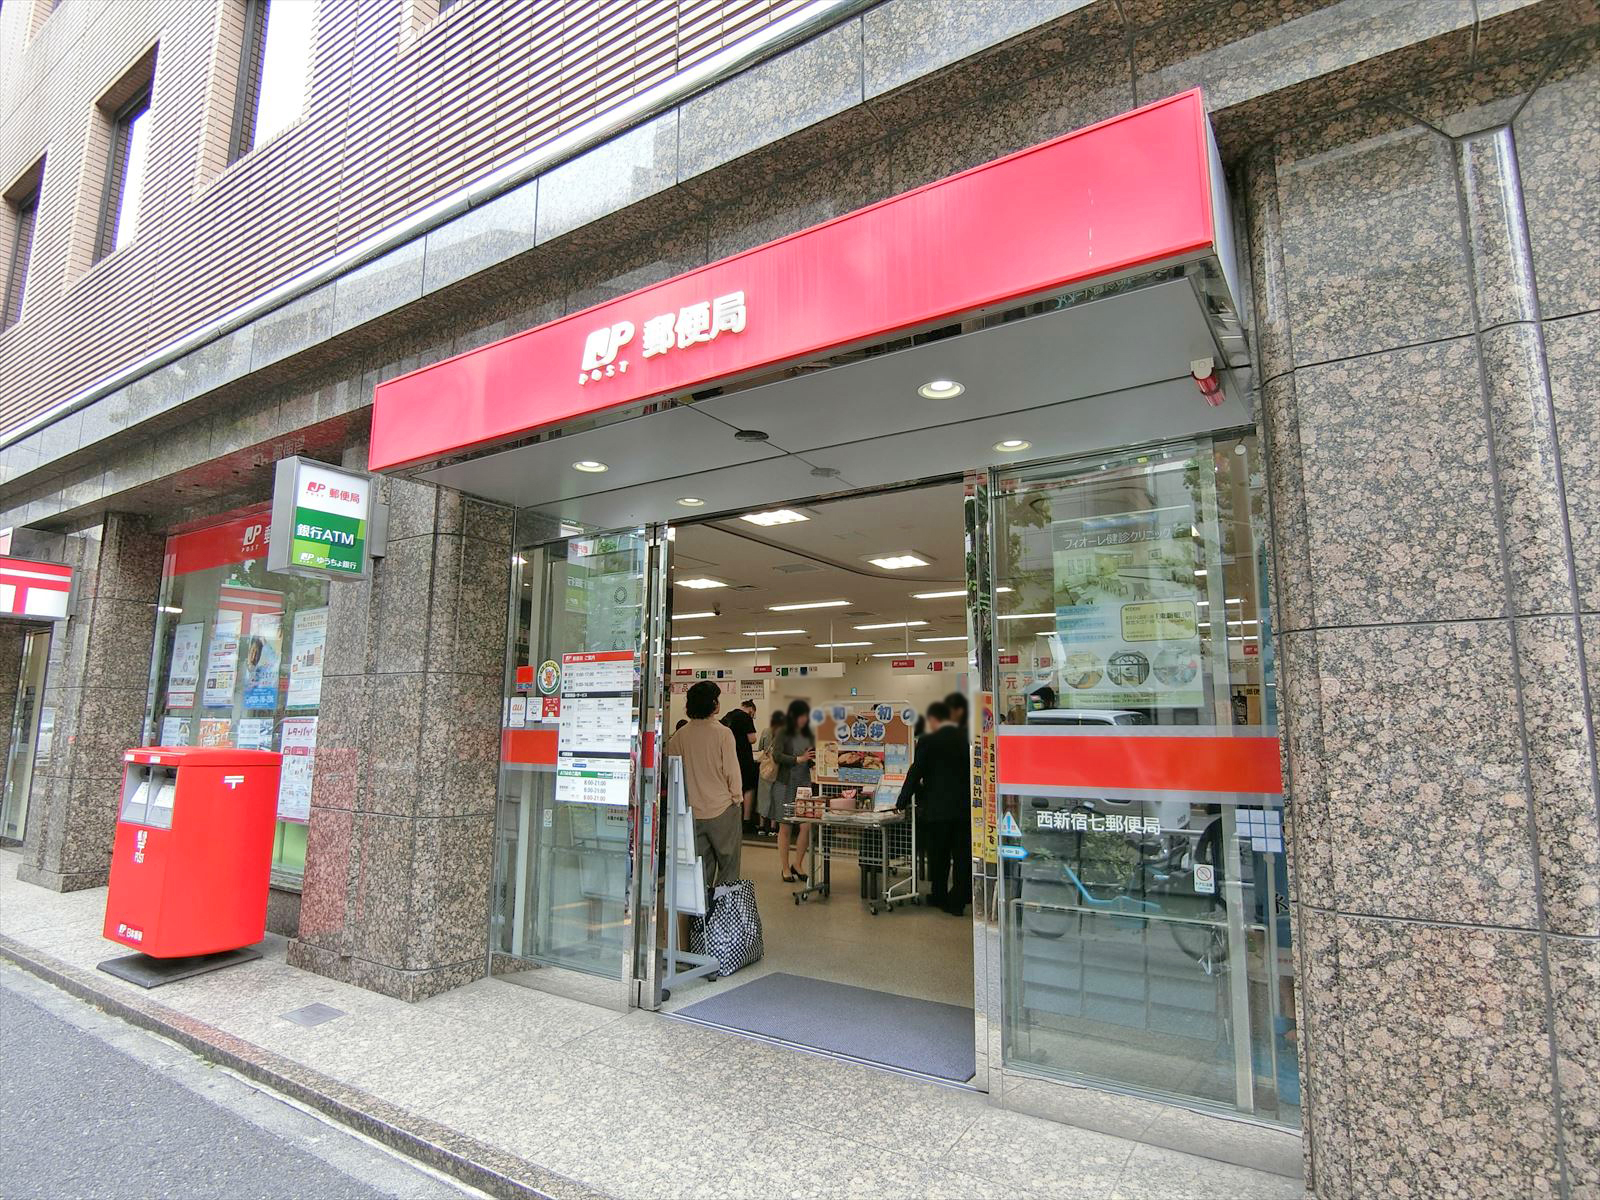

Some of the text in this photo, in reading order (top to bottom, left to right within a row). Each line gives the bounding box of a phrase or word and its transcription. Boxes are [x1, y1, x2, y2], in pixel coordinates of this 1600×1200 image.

[642, 291, 747, 358] 郵便局
[578, 360, 629, 385] POST
[329, 488, 360, 504] 郵便局
[296, 523, 354, 546] 銀行ATM
[1064, 527, 1171, 550] フィオーレ健診クリニック
[316, 556, 357, 570] ゆうちょ銀行
[776, 668, 781, 676] 5
[927, 662, 933, 672] 4
[1033, 658, 1039, 667] 3
[1036, 811, 1161, 835] 西新宿七郵便局
